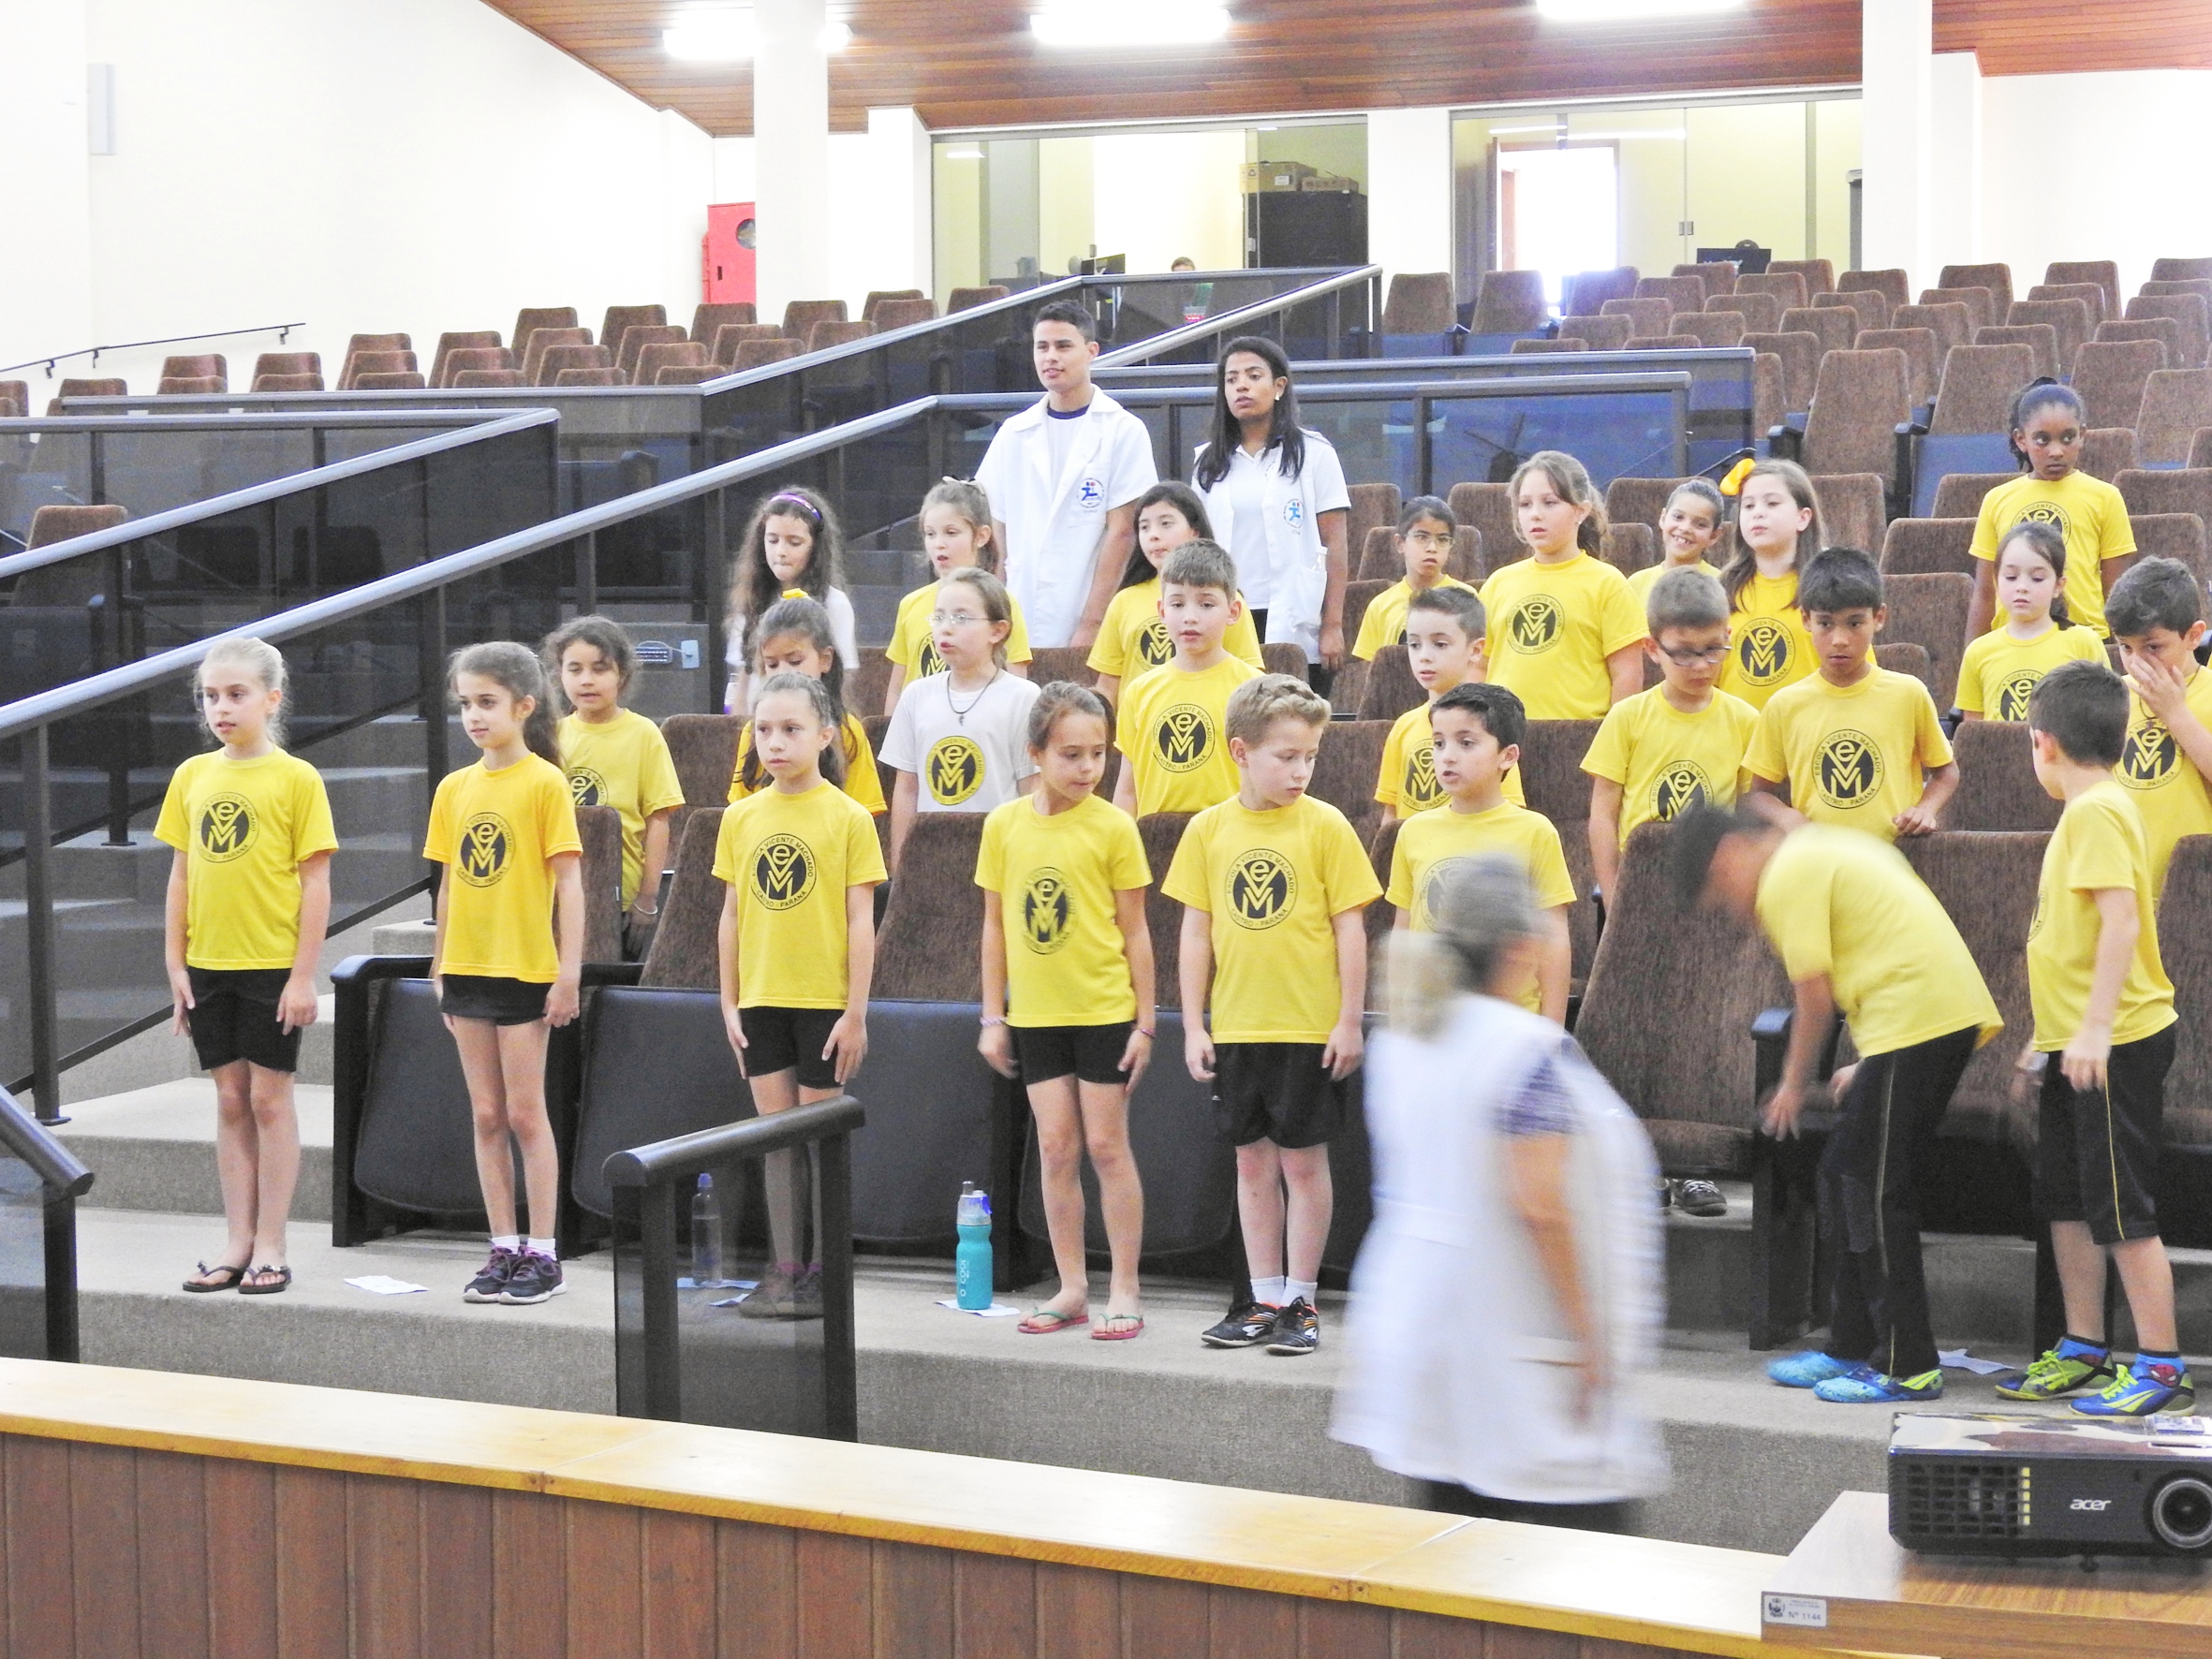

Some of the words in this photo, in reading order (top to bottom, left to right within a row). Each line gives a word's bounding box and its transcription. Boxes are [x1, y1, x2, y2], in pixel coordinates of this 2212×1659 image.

[763, 836, 795, 847] VICENTE
[795, 842, 815, 877] MACHADO
[1240, 851, 1275, 863] VICENTE
[2070, 1498, 2112, 1511] acer
